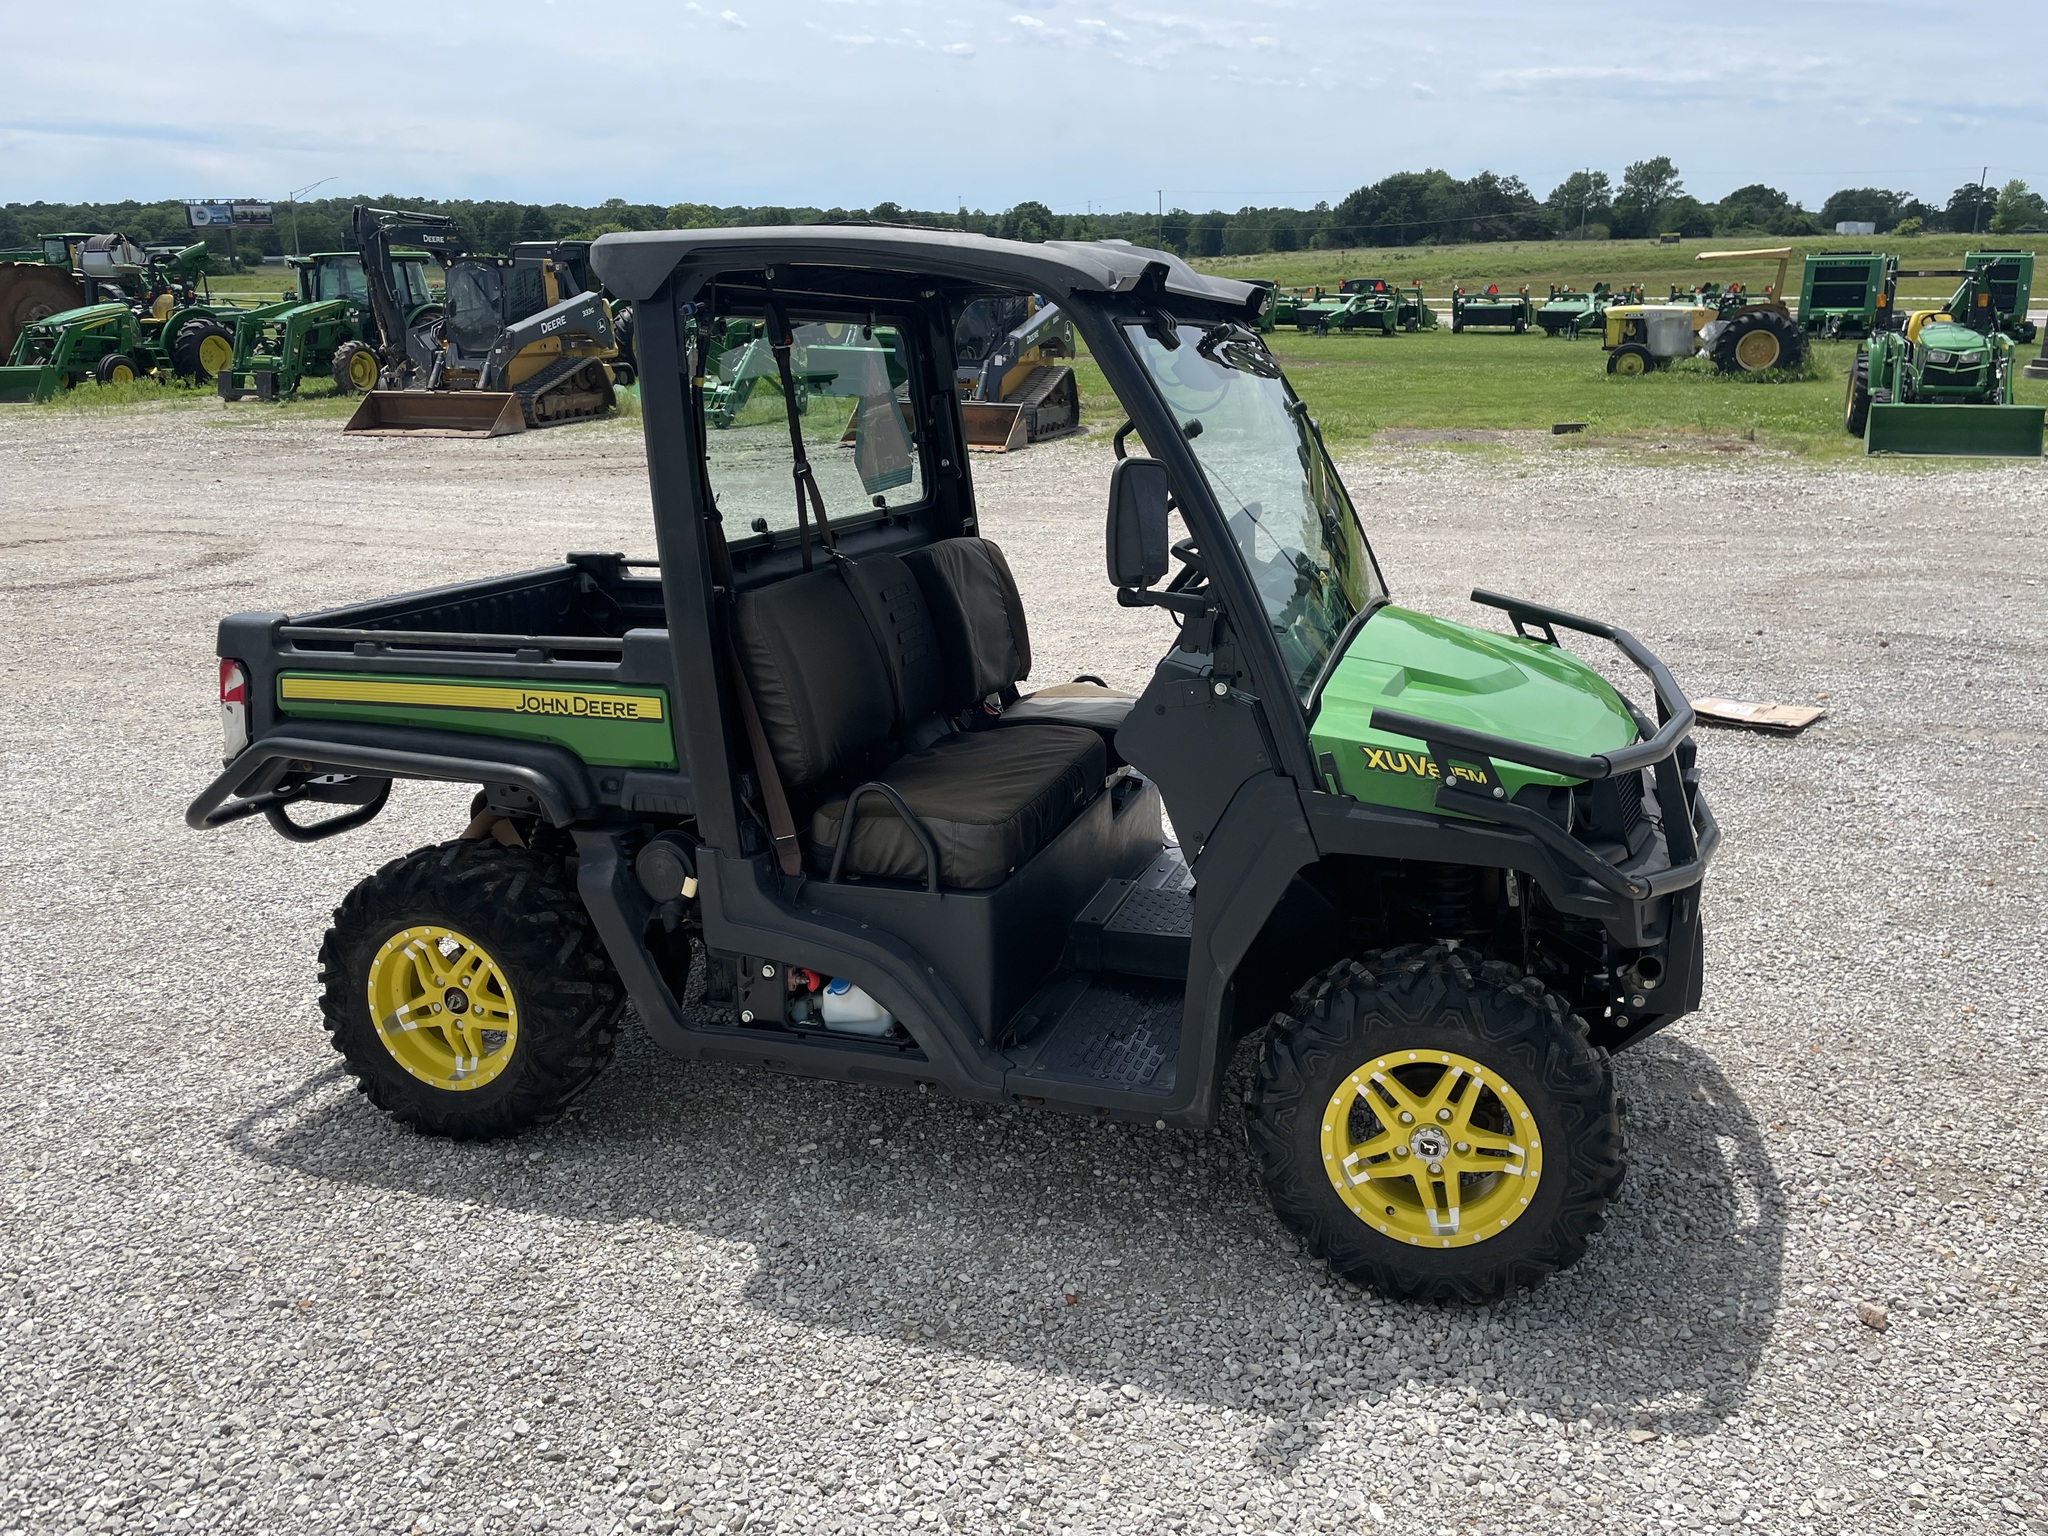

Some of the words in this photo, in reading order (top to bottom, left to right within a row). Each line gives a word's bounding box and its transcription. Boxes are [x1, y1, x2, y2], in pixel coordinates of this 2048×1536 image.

[423, 234, 445, 243] DEERE
[582, 307, 595, 317] 333G
[540, 315, 567, 334] DEERE
[516, 693, 568, 713] JOHN
[573, 696, 638, 717] DEERE
[1362, 747, 1488, 784] XUV85M
